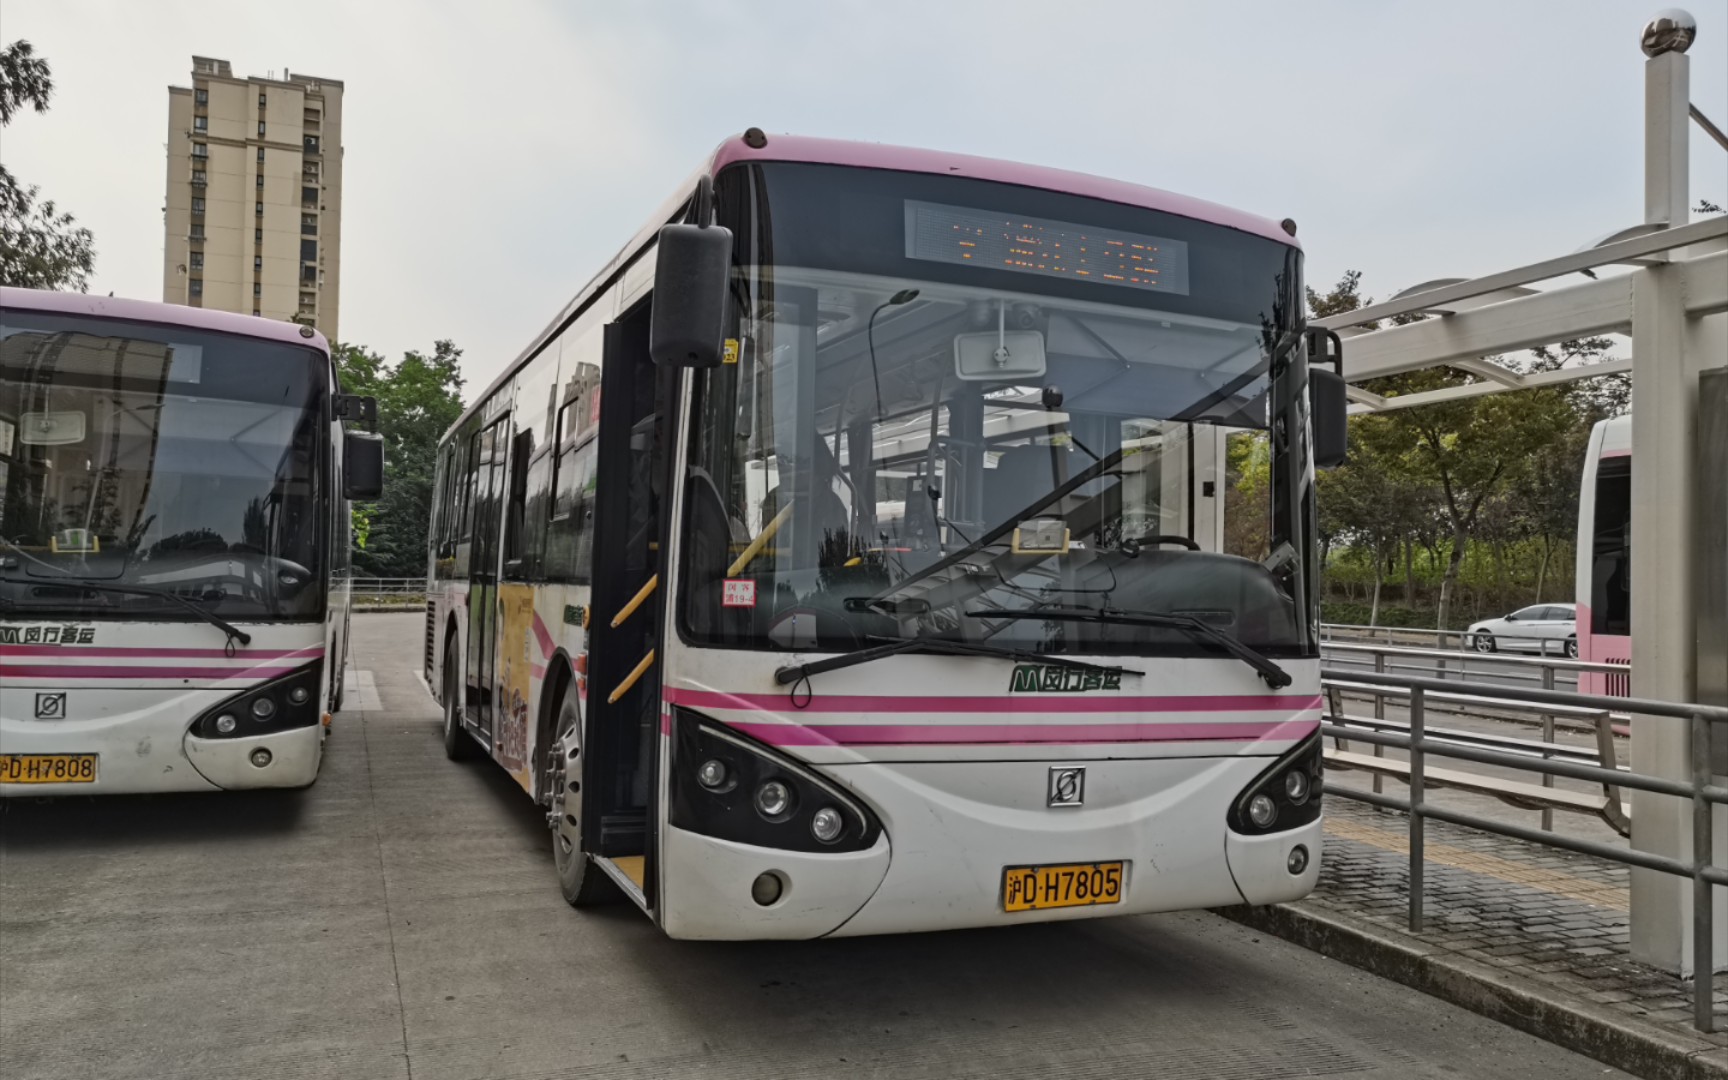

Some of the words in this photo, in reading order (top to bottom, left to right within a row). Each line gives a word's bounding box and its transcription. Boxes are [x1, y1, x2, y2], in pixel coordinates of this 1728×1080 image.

[24, 623, 95, 643] 闵行客运
[1008, 868, 1119, 905] 沪D·H7805
